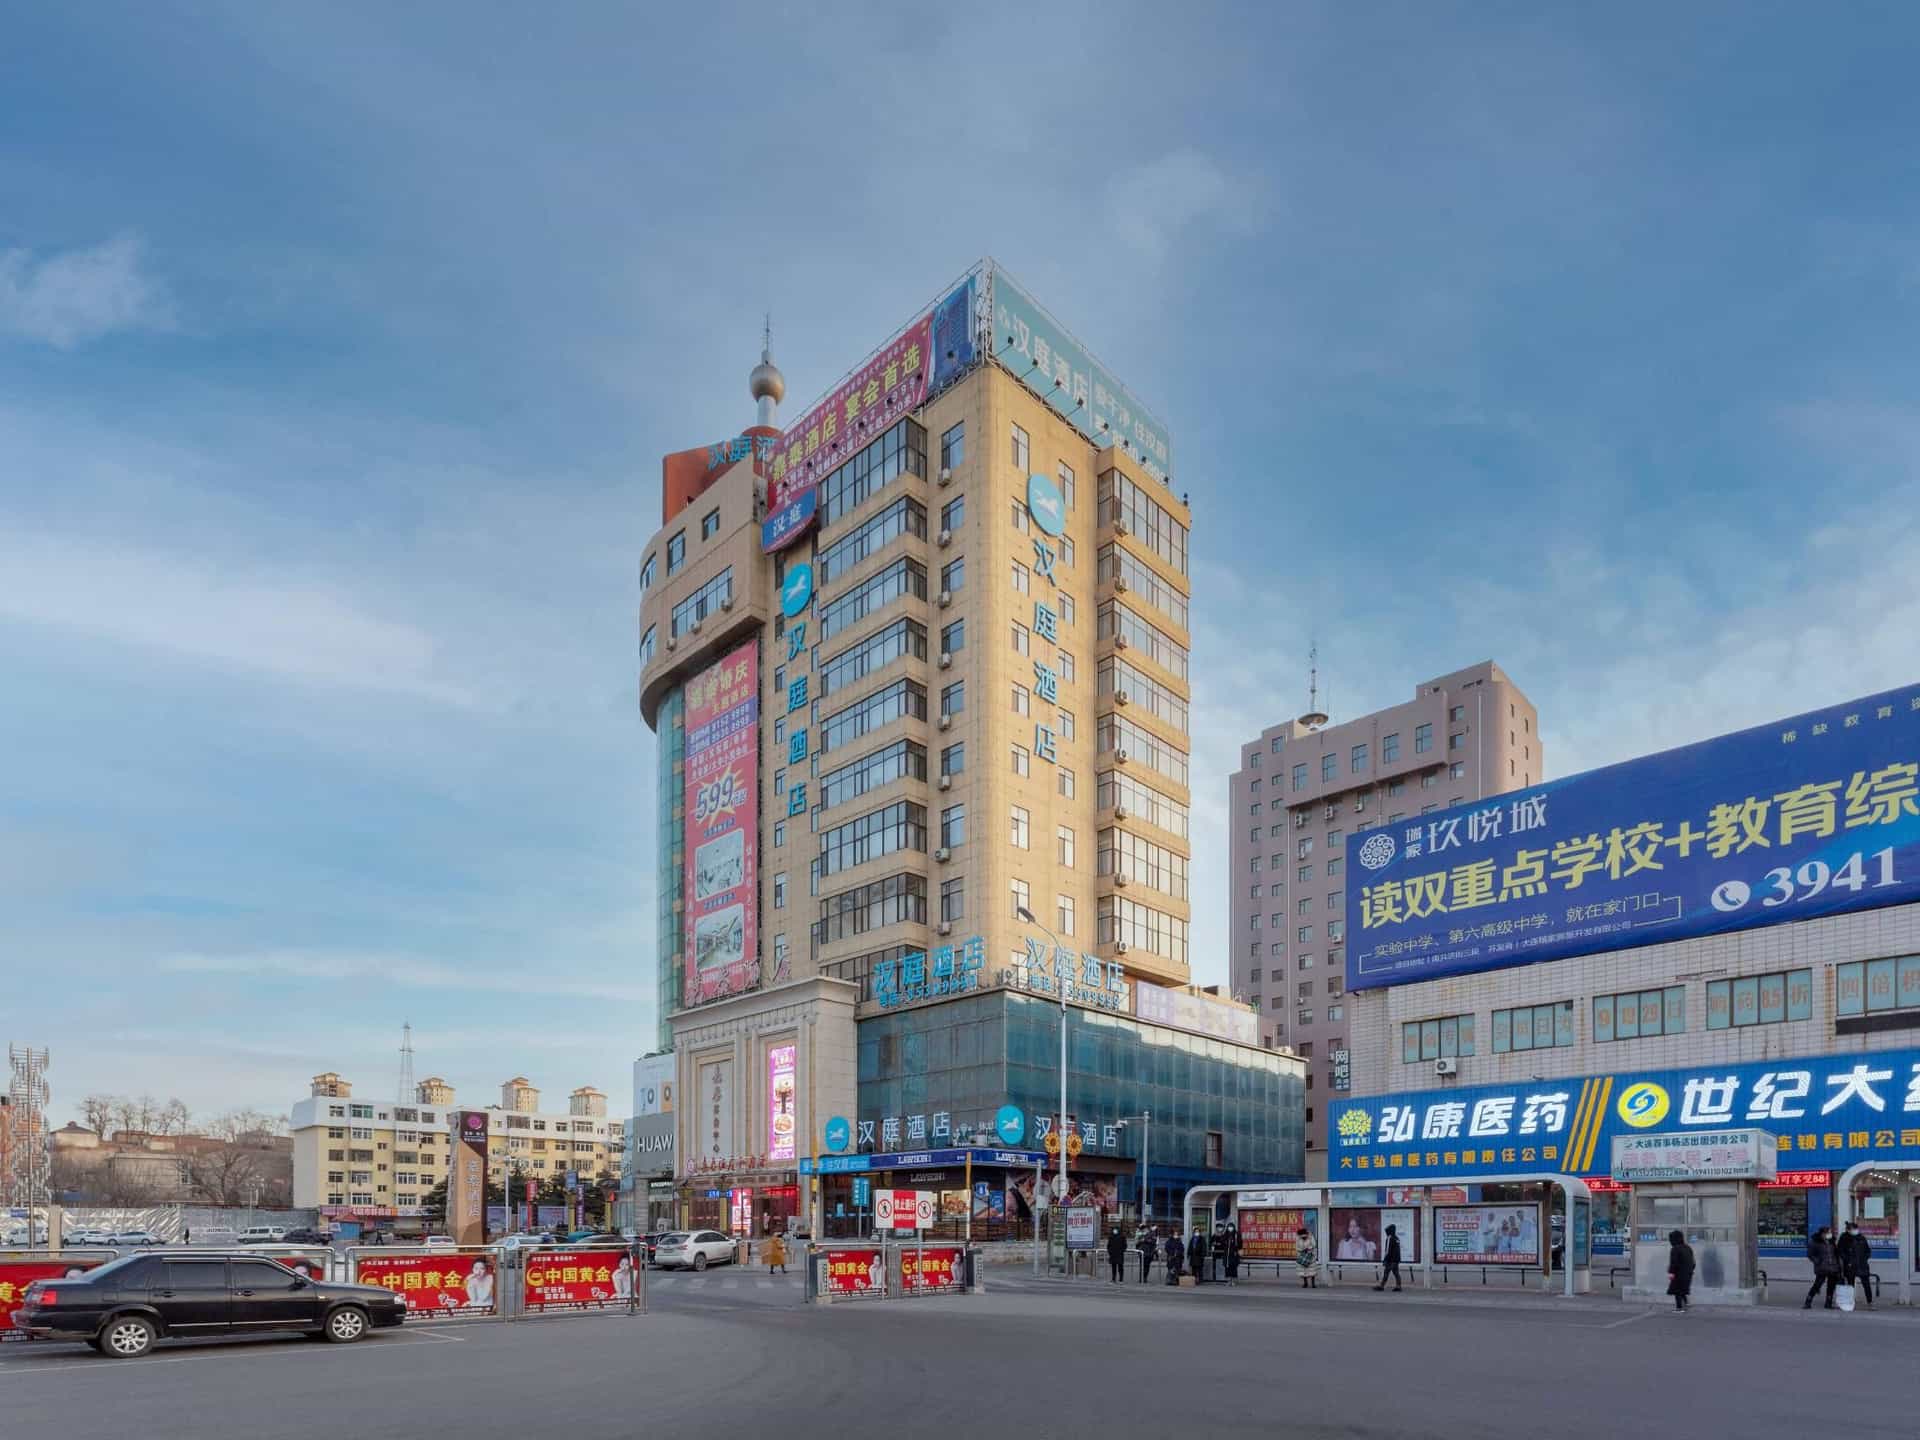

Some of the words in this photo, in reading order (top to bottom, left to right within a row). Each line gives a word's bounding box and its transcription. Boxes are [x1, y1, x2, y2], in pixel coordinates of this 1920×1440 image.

[1032, 537, 1057, 764] 汉庭酒店
[785, 621, 808, 817] 汉庭酒店
[1429, 794, 1547, 853] 玖悦城
[1762, 846, 1902, 908] 3941
[875, 935, 985, 993] 汉庭酒店
[1335, 1050, 1349, 1078] 网吧
[858, 1111, 950, 1144] 汉庭酒店
[1377, 1092, 1570, 1143] 弘康医药
[1680, 1064, 1920, 1124] 世纪大
[383, 1271, 462, 1290] 中国黄金
[546, 1266, 610, 1284] 中国黄金
